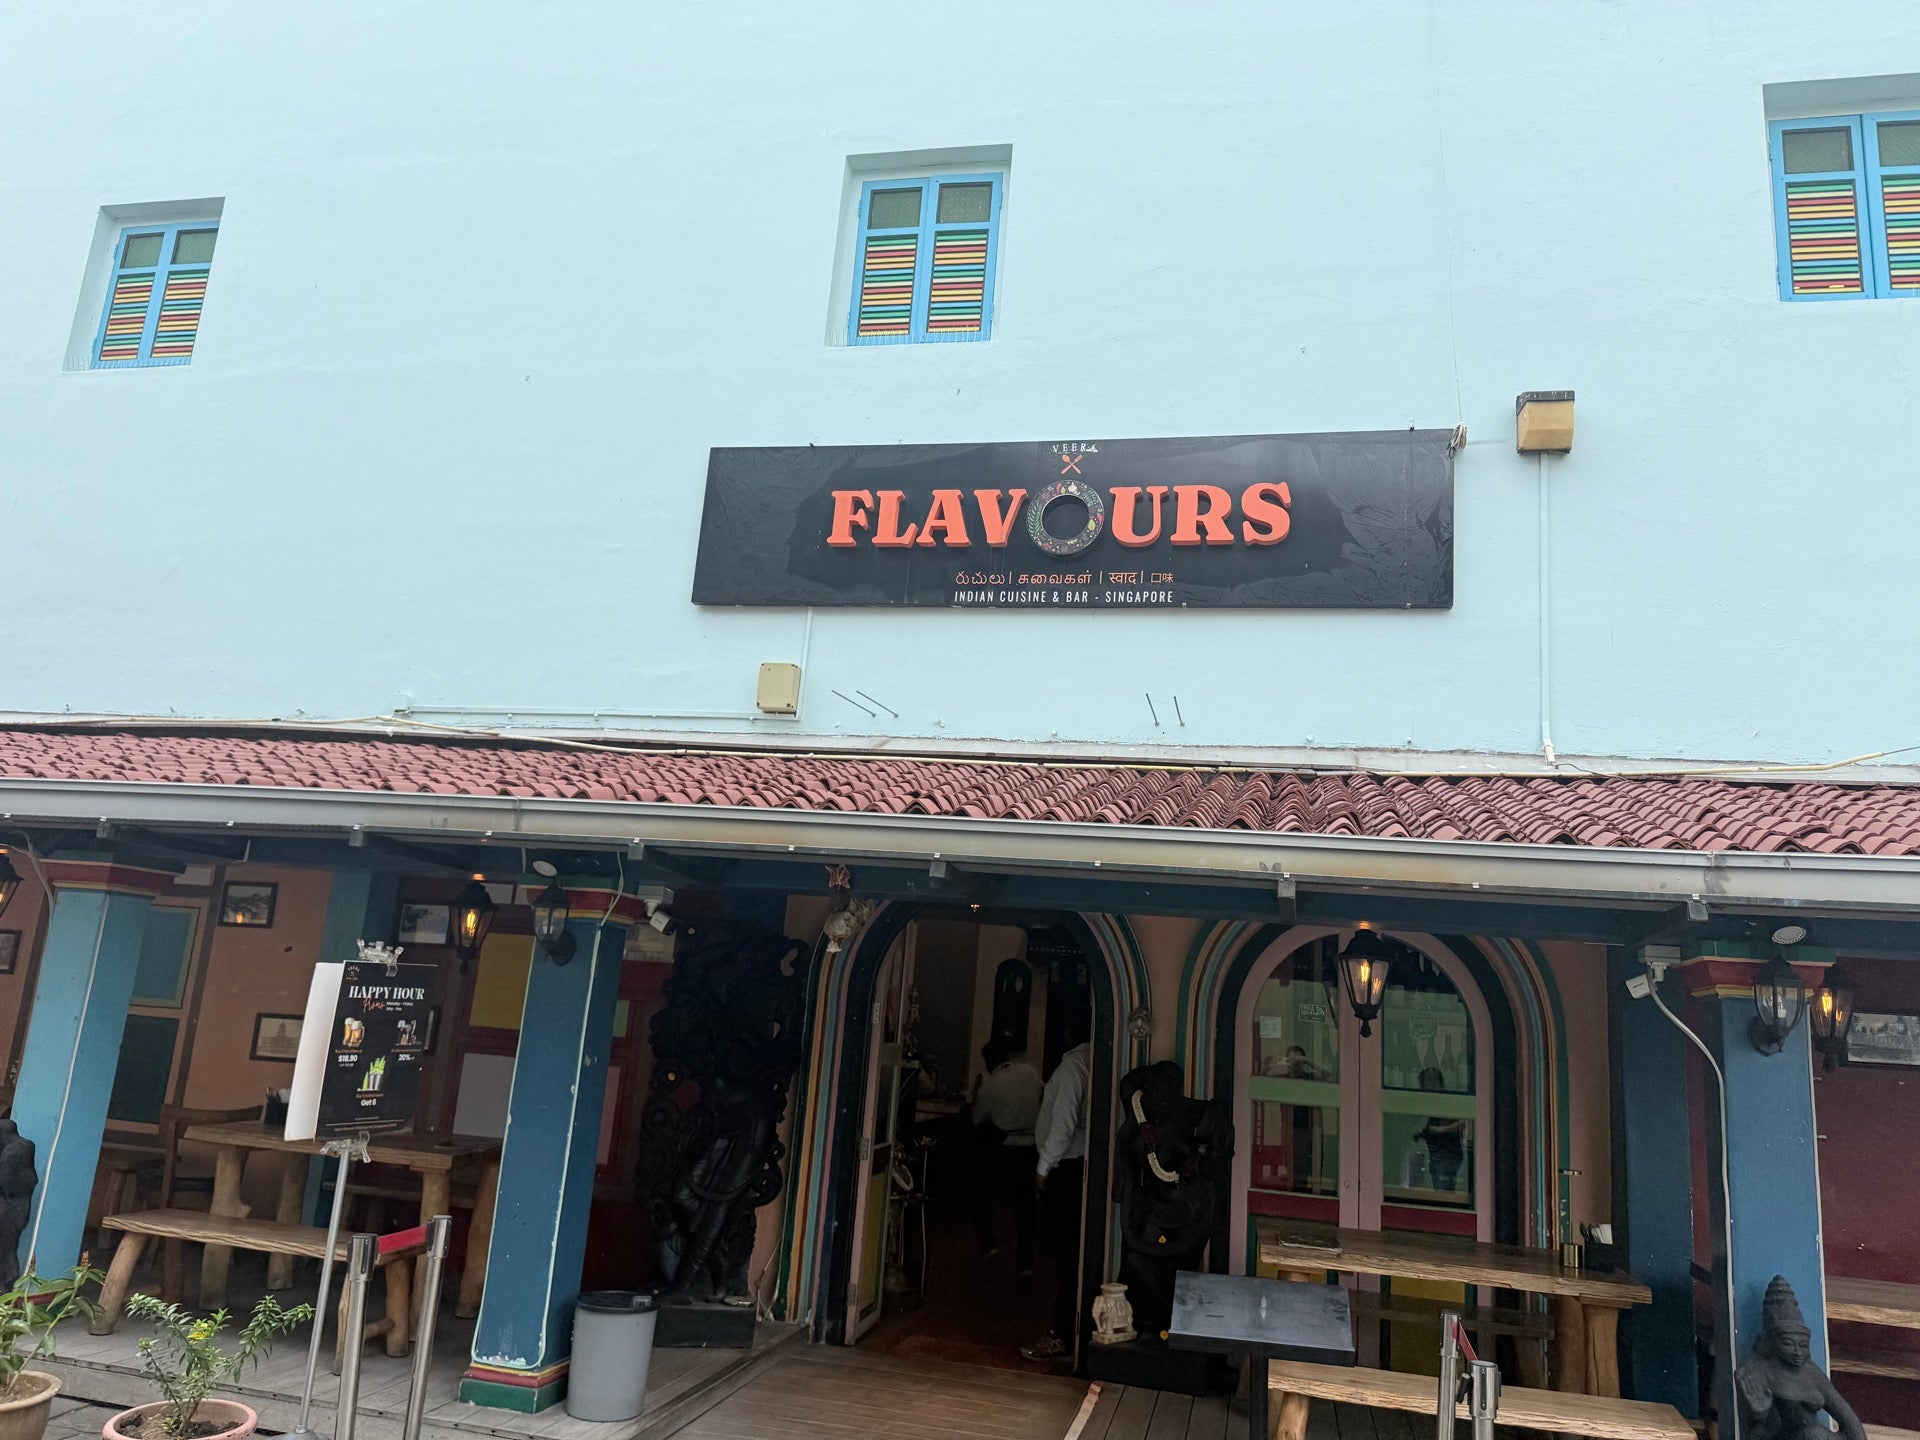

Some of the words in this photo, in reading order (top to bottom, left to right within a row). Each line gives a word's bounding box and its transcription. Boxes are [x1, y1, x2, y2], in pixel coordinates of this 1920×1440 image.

[827, 480, 1292, 556] FLAVOURS
[1108, 572, 1138, 585] स्वाद
[954, 591, 994, 602] INDIAN
[999, 591, 1046, 602] CUISINE
[1052, 591, 1059, 603] &
[1066, 591, 1088, 602] BAR
[1105, 591, 1173, 603] SINGAPORE
[348, 985, 391, 999] HAPPY
[392, 987, 425, 1000] HOUR
